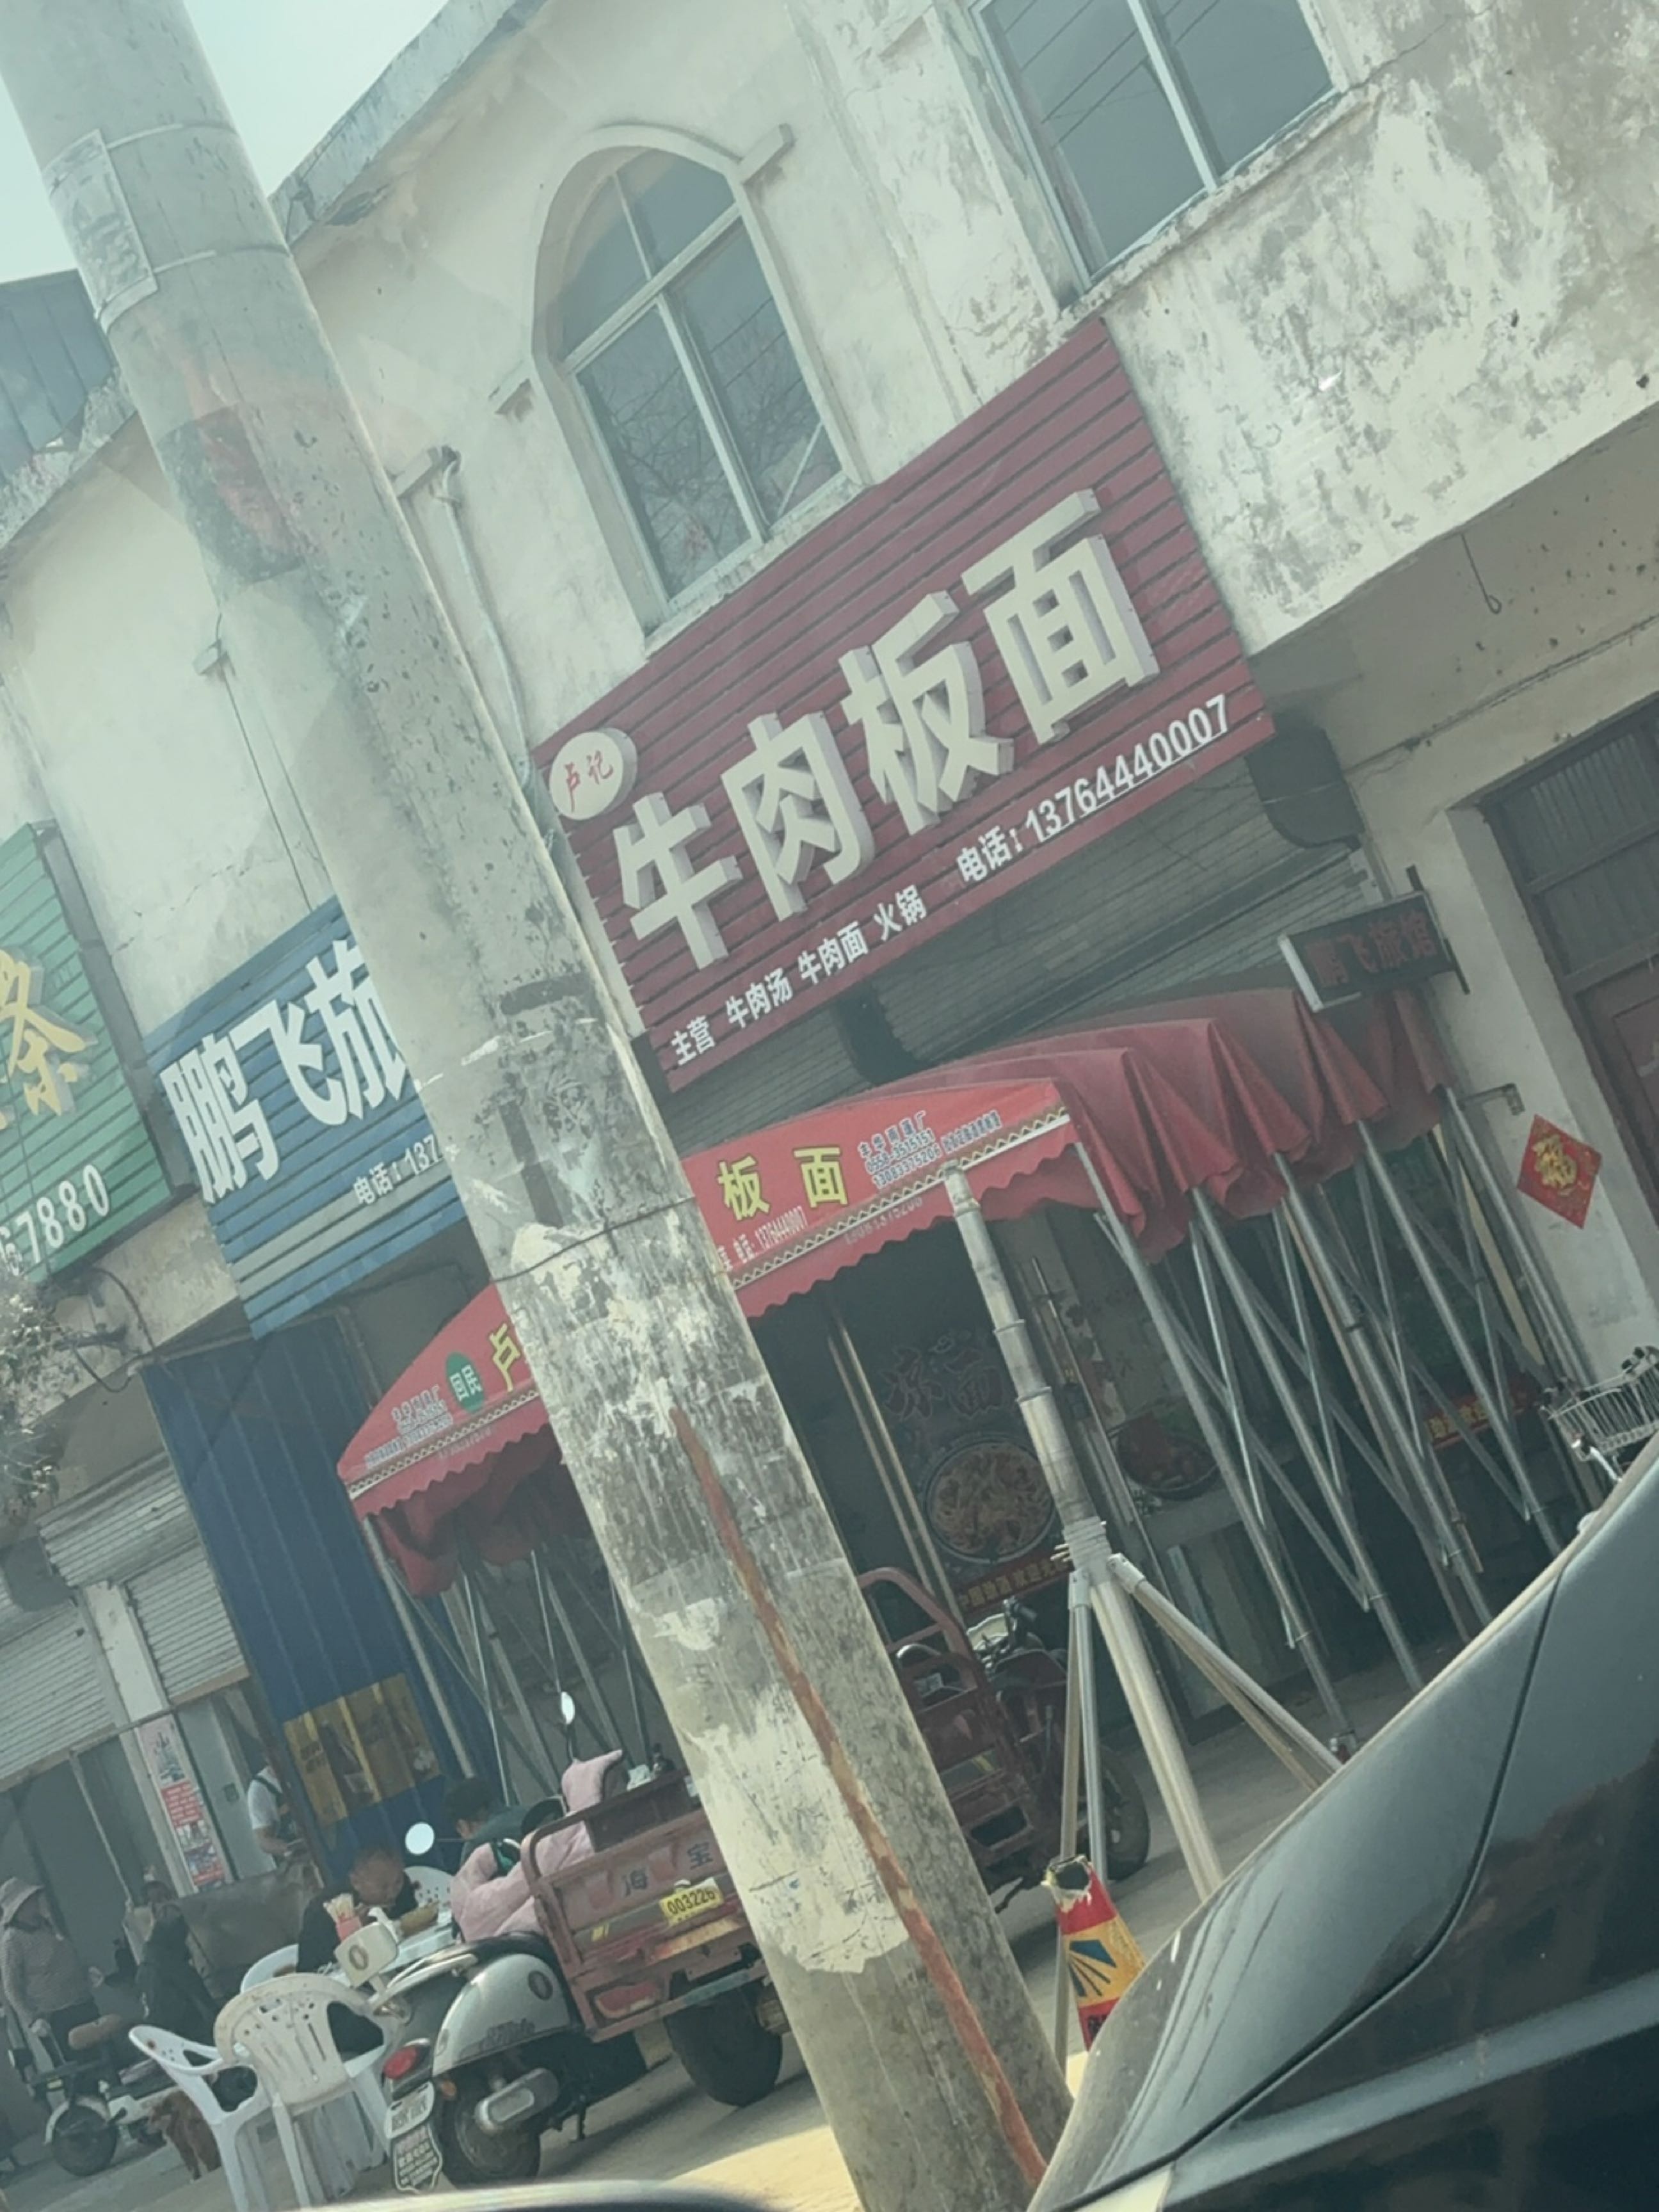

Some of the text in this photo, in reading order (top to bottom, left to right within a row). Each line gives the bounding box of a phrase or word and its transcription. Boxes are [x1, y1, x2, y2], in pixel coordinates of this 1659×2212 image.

[561, 749, 614, 811] 卢记
[613, 488, 1160, 969] 牛肉板面
[671, 1015, 716, 1066] 主营
[725, 968, 793, 1028] 牛肉汤
[797, 921, 869, 985] 牛肉面
[874, 885, 927, 941] 火锅
[489, 1323, 521, 1393] 卢
[717, 1146, 848, 1221] 板面
